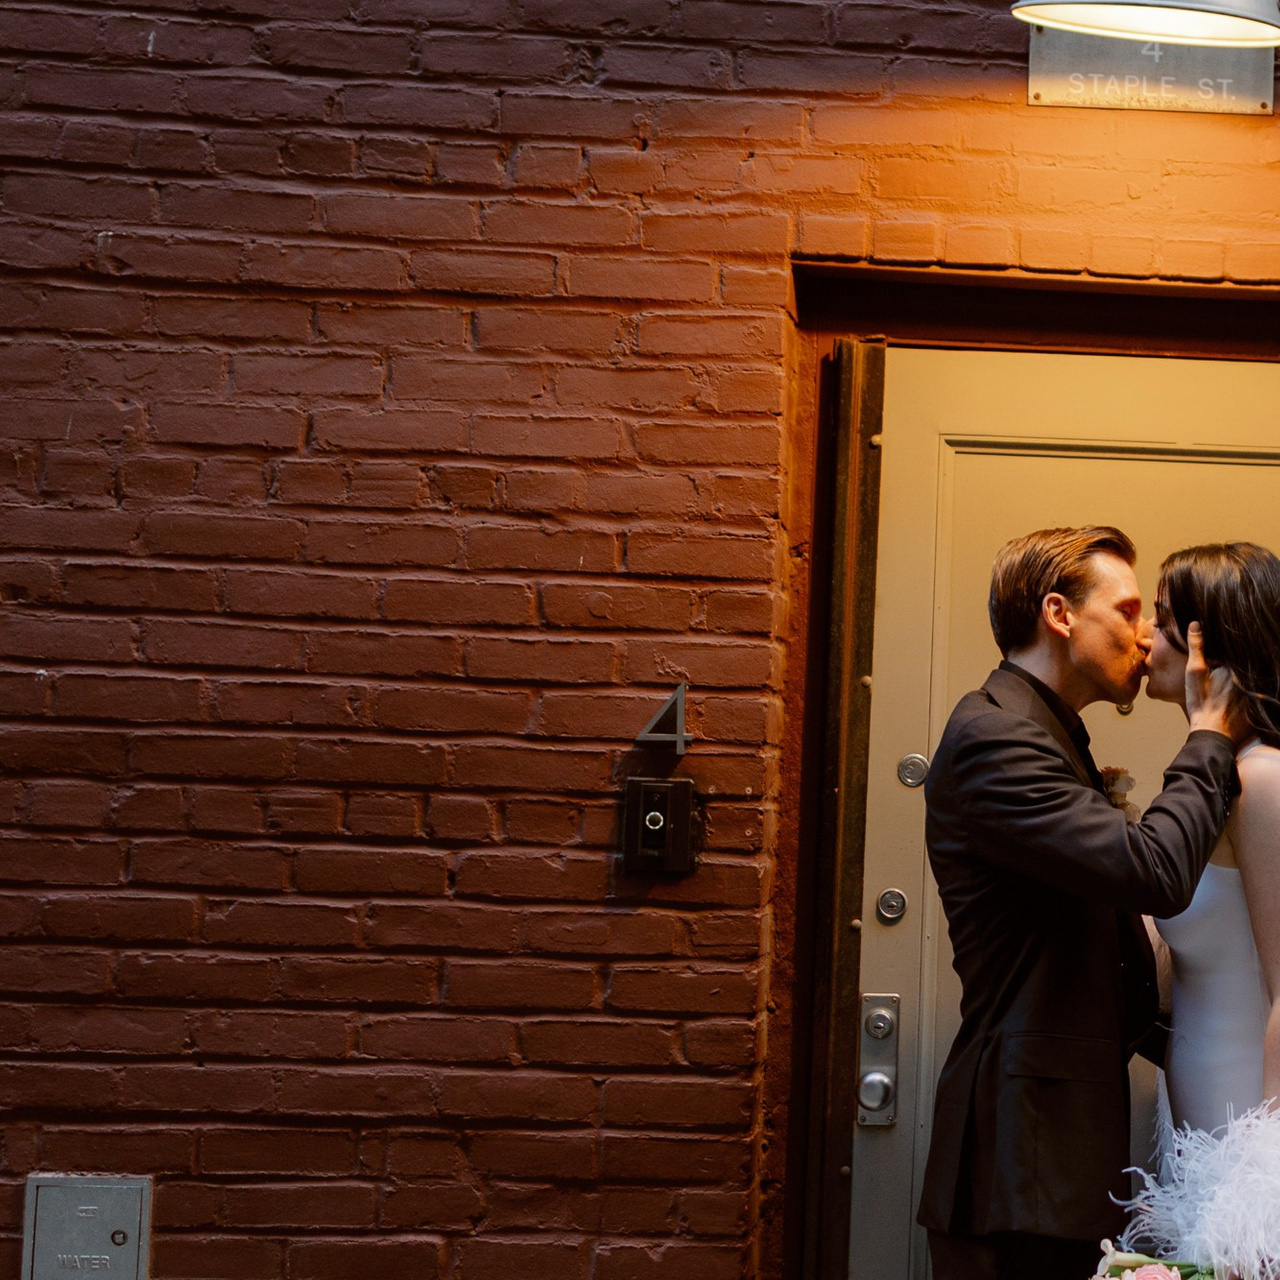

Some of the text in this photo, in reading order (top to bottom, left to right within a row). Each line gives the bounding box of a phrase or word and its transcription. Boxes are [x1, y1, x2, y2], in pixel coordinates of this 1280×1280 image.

[1140, 41, 1165, 63] 4
[1068, 72, 1237, 101] STAPLE ST.
[635, 680, 694, 755] 4
[57, 1254, 111, 1270] WATER
